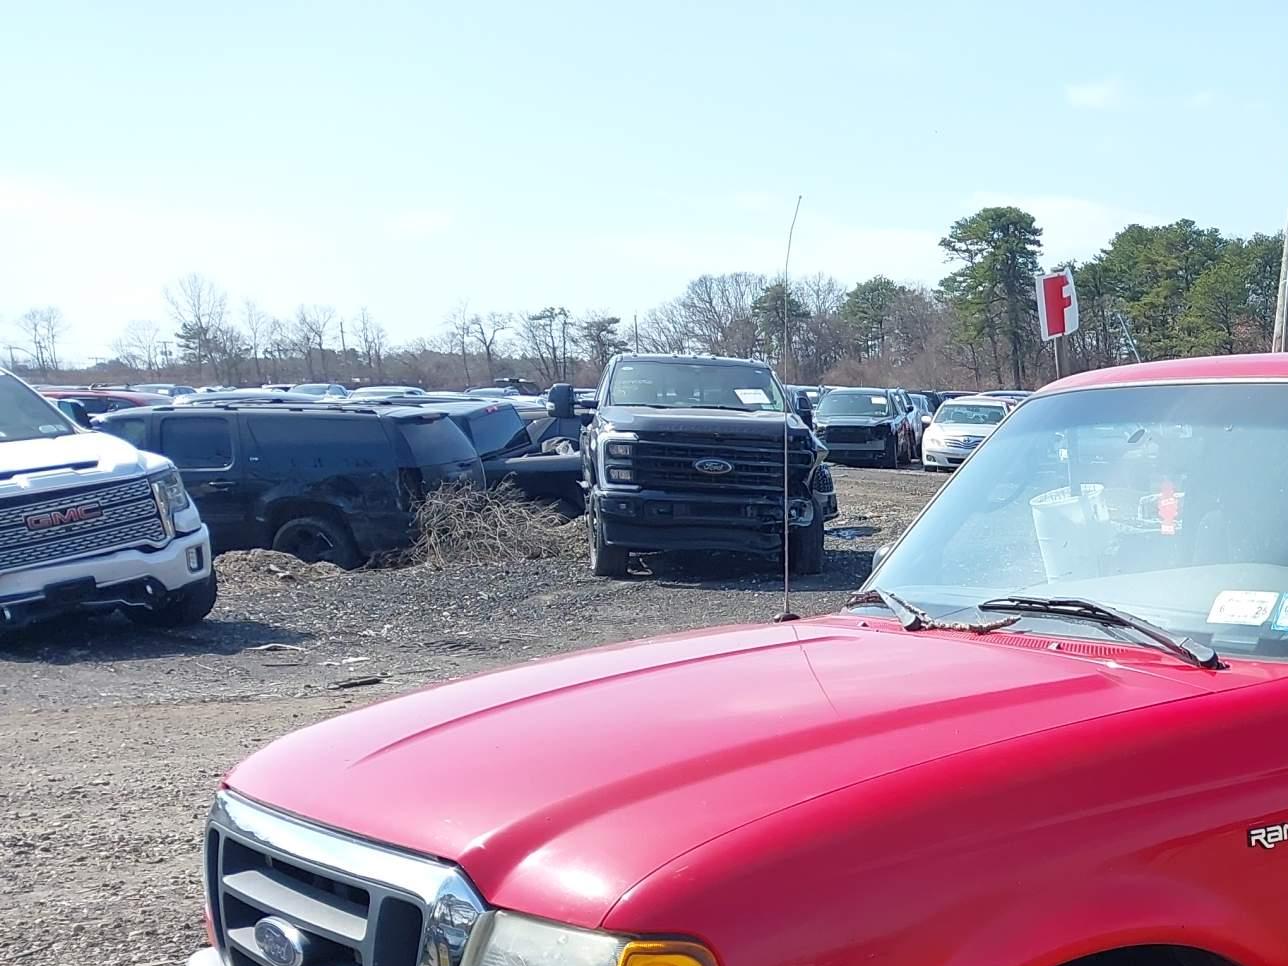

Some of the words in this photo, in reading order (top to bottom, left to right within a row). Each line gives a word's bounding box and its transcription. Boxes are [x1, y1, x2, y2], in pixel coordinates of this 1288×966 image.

[1042, 274, 1073, 337] F
[26, 502, 102, 530] GMC
[263, 927, 289, 961] Ford
